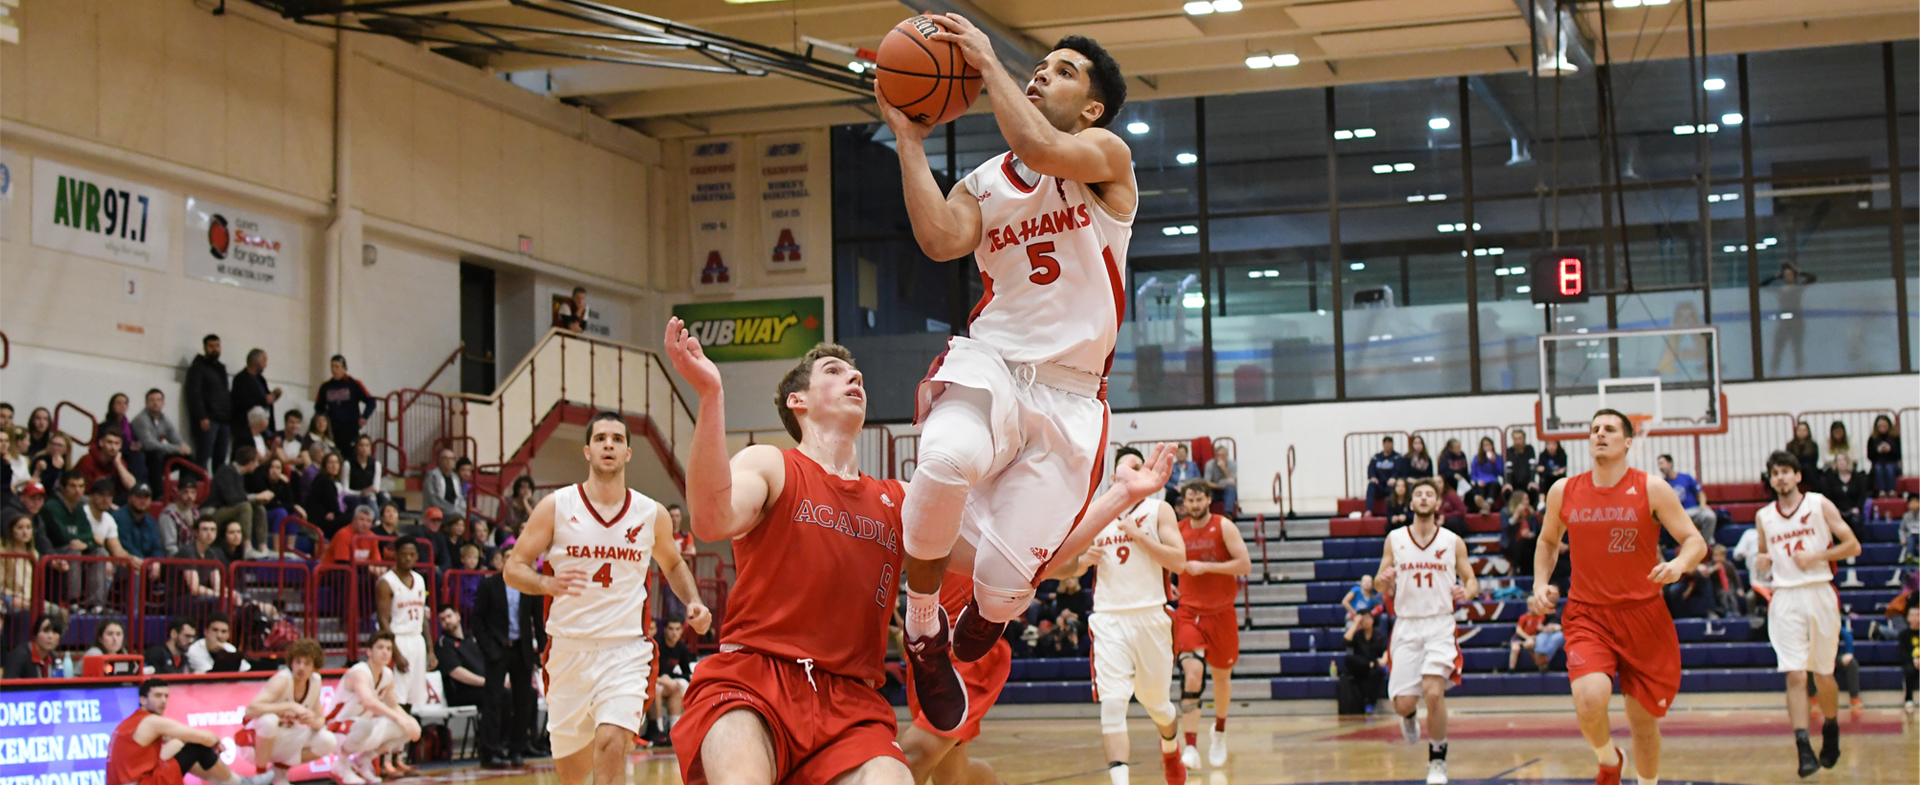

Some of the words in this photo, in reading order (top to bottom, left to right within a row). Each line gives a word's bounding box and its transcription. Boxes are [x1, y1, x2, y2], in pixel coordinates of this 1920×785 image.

[1026, 240, 1061, 286] 5
[1559, 258, 1582, 296] 8
[690, 313, 798, 347] SUBWAY
[794, 498, 899, 556] ACADIA
[1568, 506, 1639, 523] ACADIA
[1608, 527, 1638, 553] 22
[1116, 545, 1130, 565] 9
[592, 562, 613, 588] 4
[875, 562, 894, 608] 9
[1413, 572, 1433, 588] 11
[38, 700, 63, 725] OF
[64, 699, 102, 723] THE
[66, 733, 111, 760] AND
